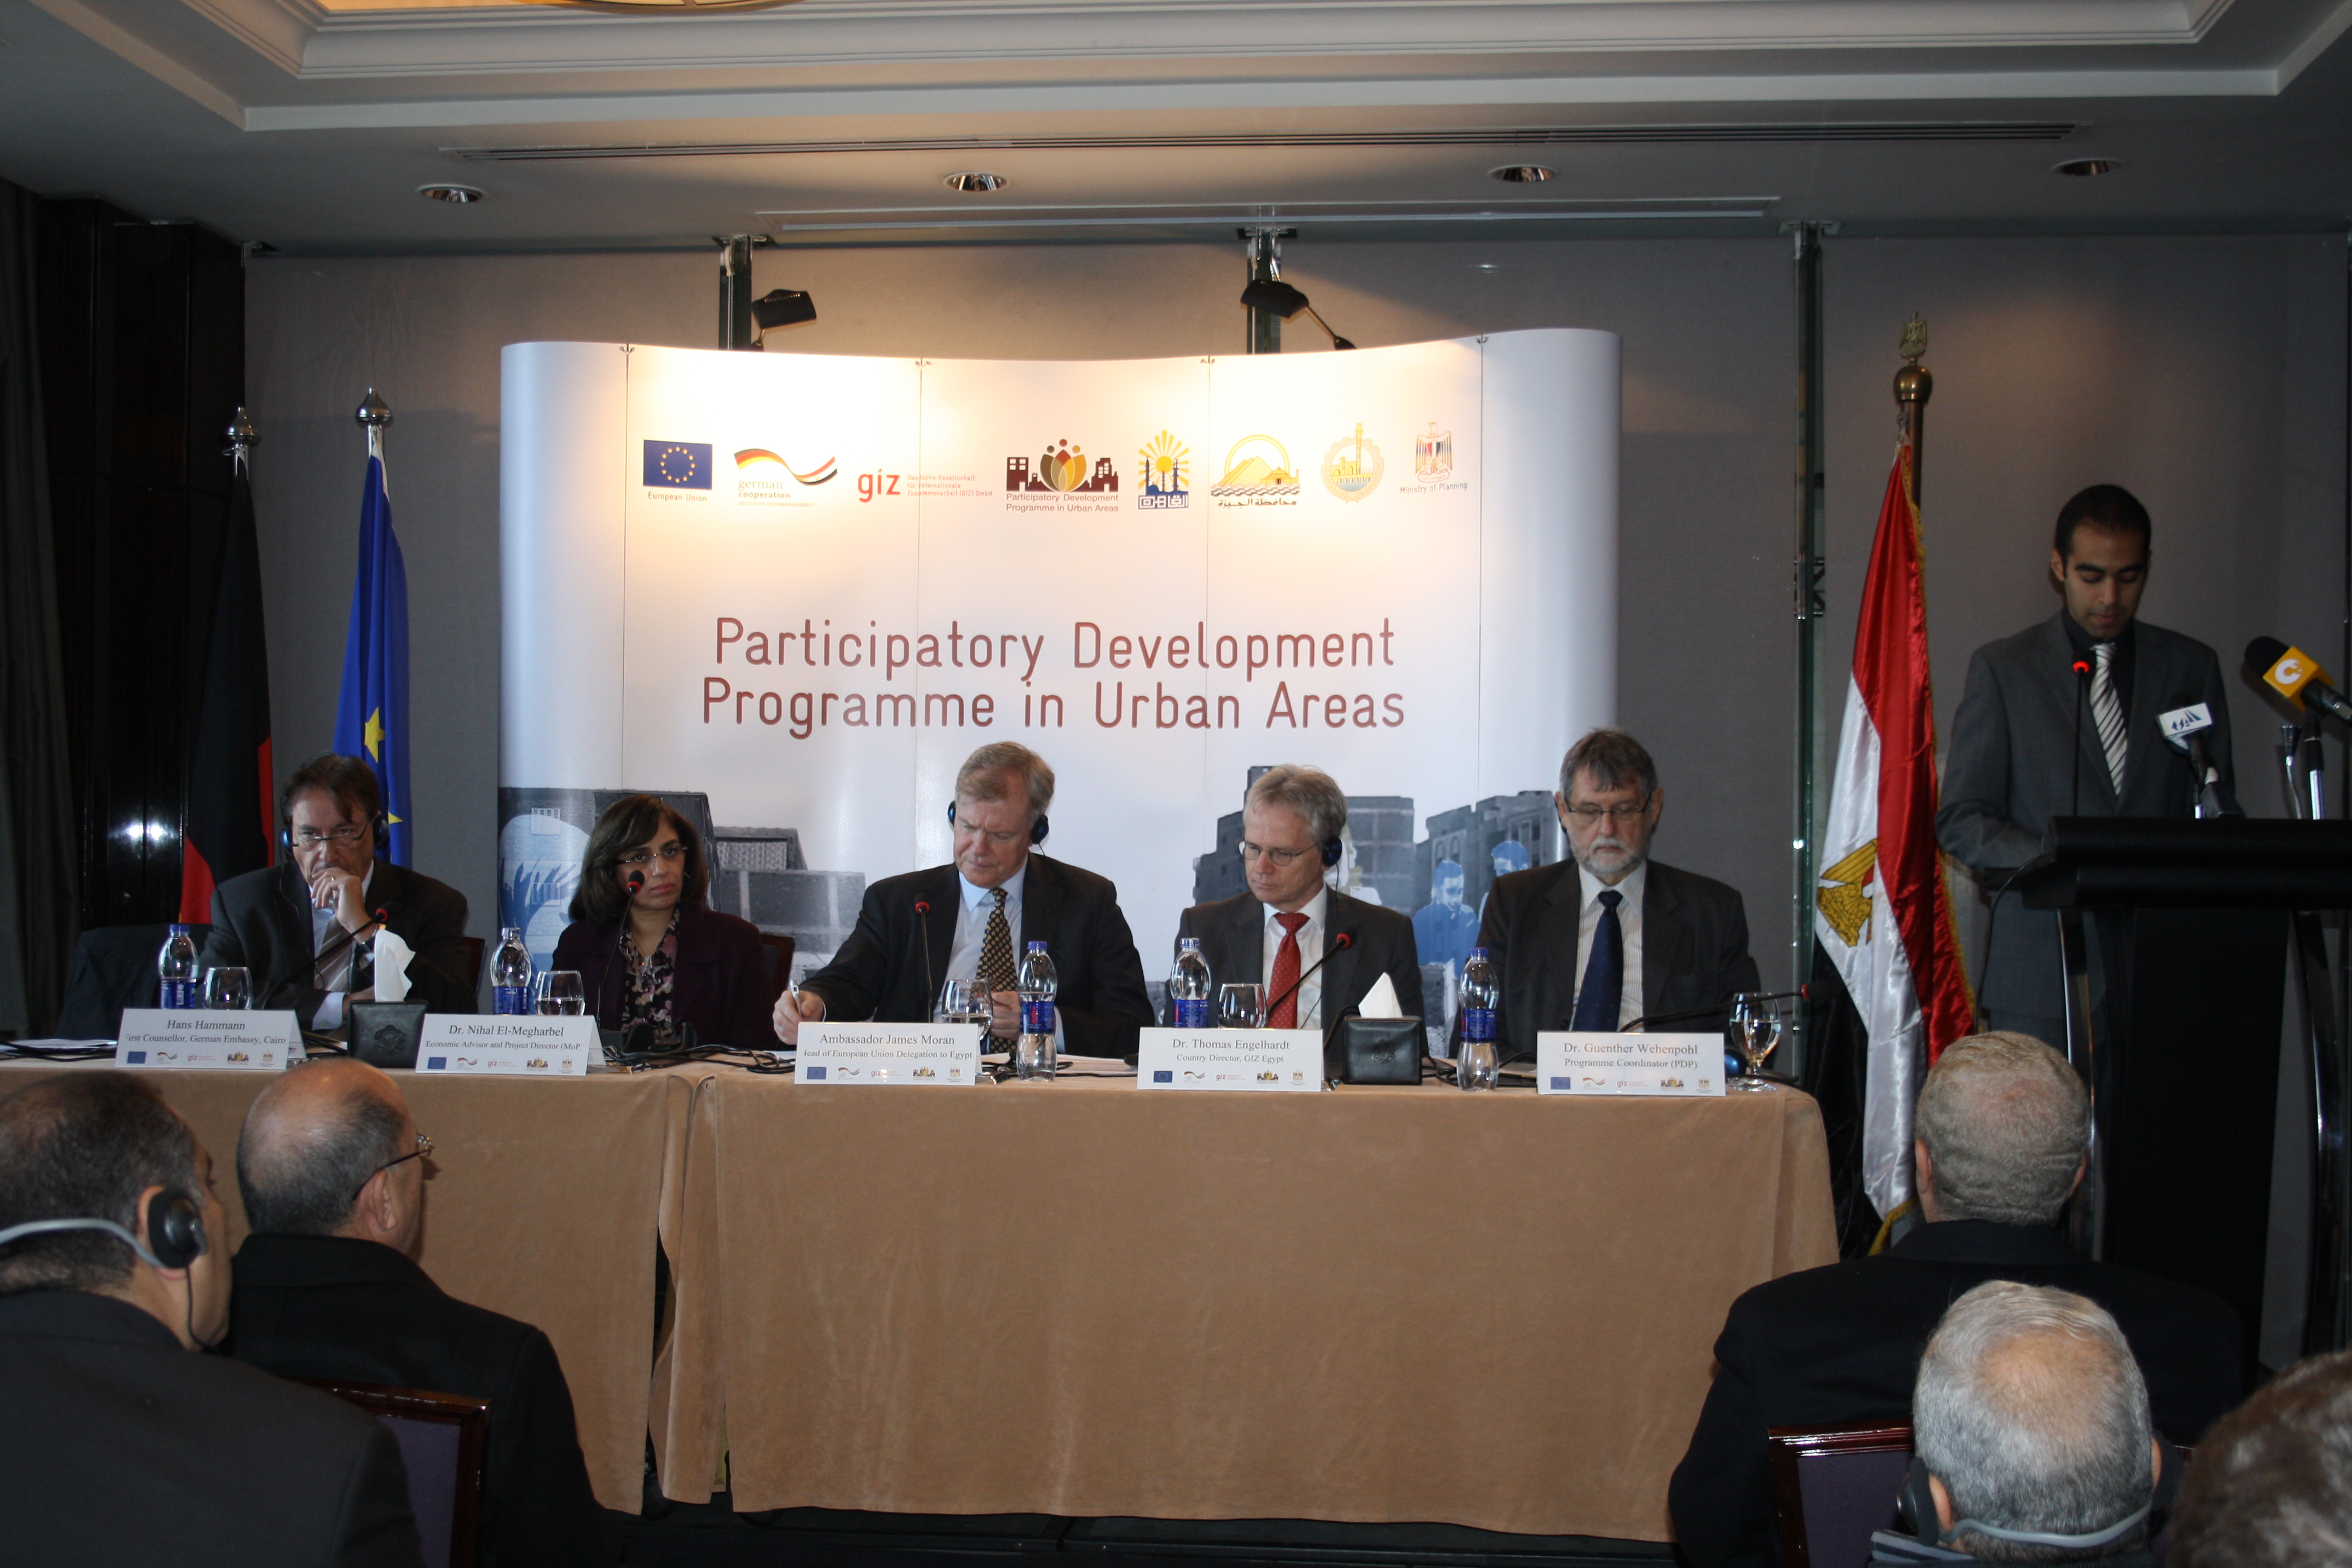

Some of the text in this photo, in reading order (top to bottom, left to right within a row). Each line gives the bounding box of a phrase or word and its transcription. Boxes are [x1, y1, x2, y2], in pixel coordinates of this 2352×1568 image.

[738, 480, 783, 491] german
[858, 468, 900, 503] giz
[1400, 481, 1467, 494] Ministry of Planning
[648, 491, 682, 501] European
[739, 491, 790, 500] cooperation
[1006, 493, 1119, 503] Participatory Development
[1006, 503, 1055, 513] Programme
[1218, 498, 1297, 509] محافظة الجيزة
[717, 618, 1396, 682] Participatory Development
[702, 677, 1405, 739] Programme in Urban Areas
[167, 1020, 245, 1030] Hans Hammann
[449, 1025, 564, 1038] Dr. Nihal El-Megharbel
[143, 1034, 188, 1043] Counsellor,
[224, 1036, 261, 1045] Embassy,
[820, 1034, 955, 1045] Ambassador James Moran
[1172, 1039, 1290, 1051] Dr. Thomas Engelhardt
[505, 1042, 529, 1050] Project
[1563, 1043, 1697, 1056] Dr. Guenther Wehenpohl
[832, 1050, 869, 1059] European
[897, 1050, 938, 1060] Delegation
[950, 1051, 973, 1060] Egypt
[1177, 1054, 1207, 1062] Country
[1262, 1055, 1284, 1063] Egypt
[1564, 1059, 1697, 1070] Programme Coordinator (PDP)
